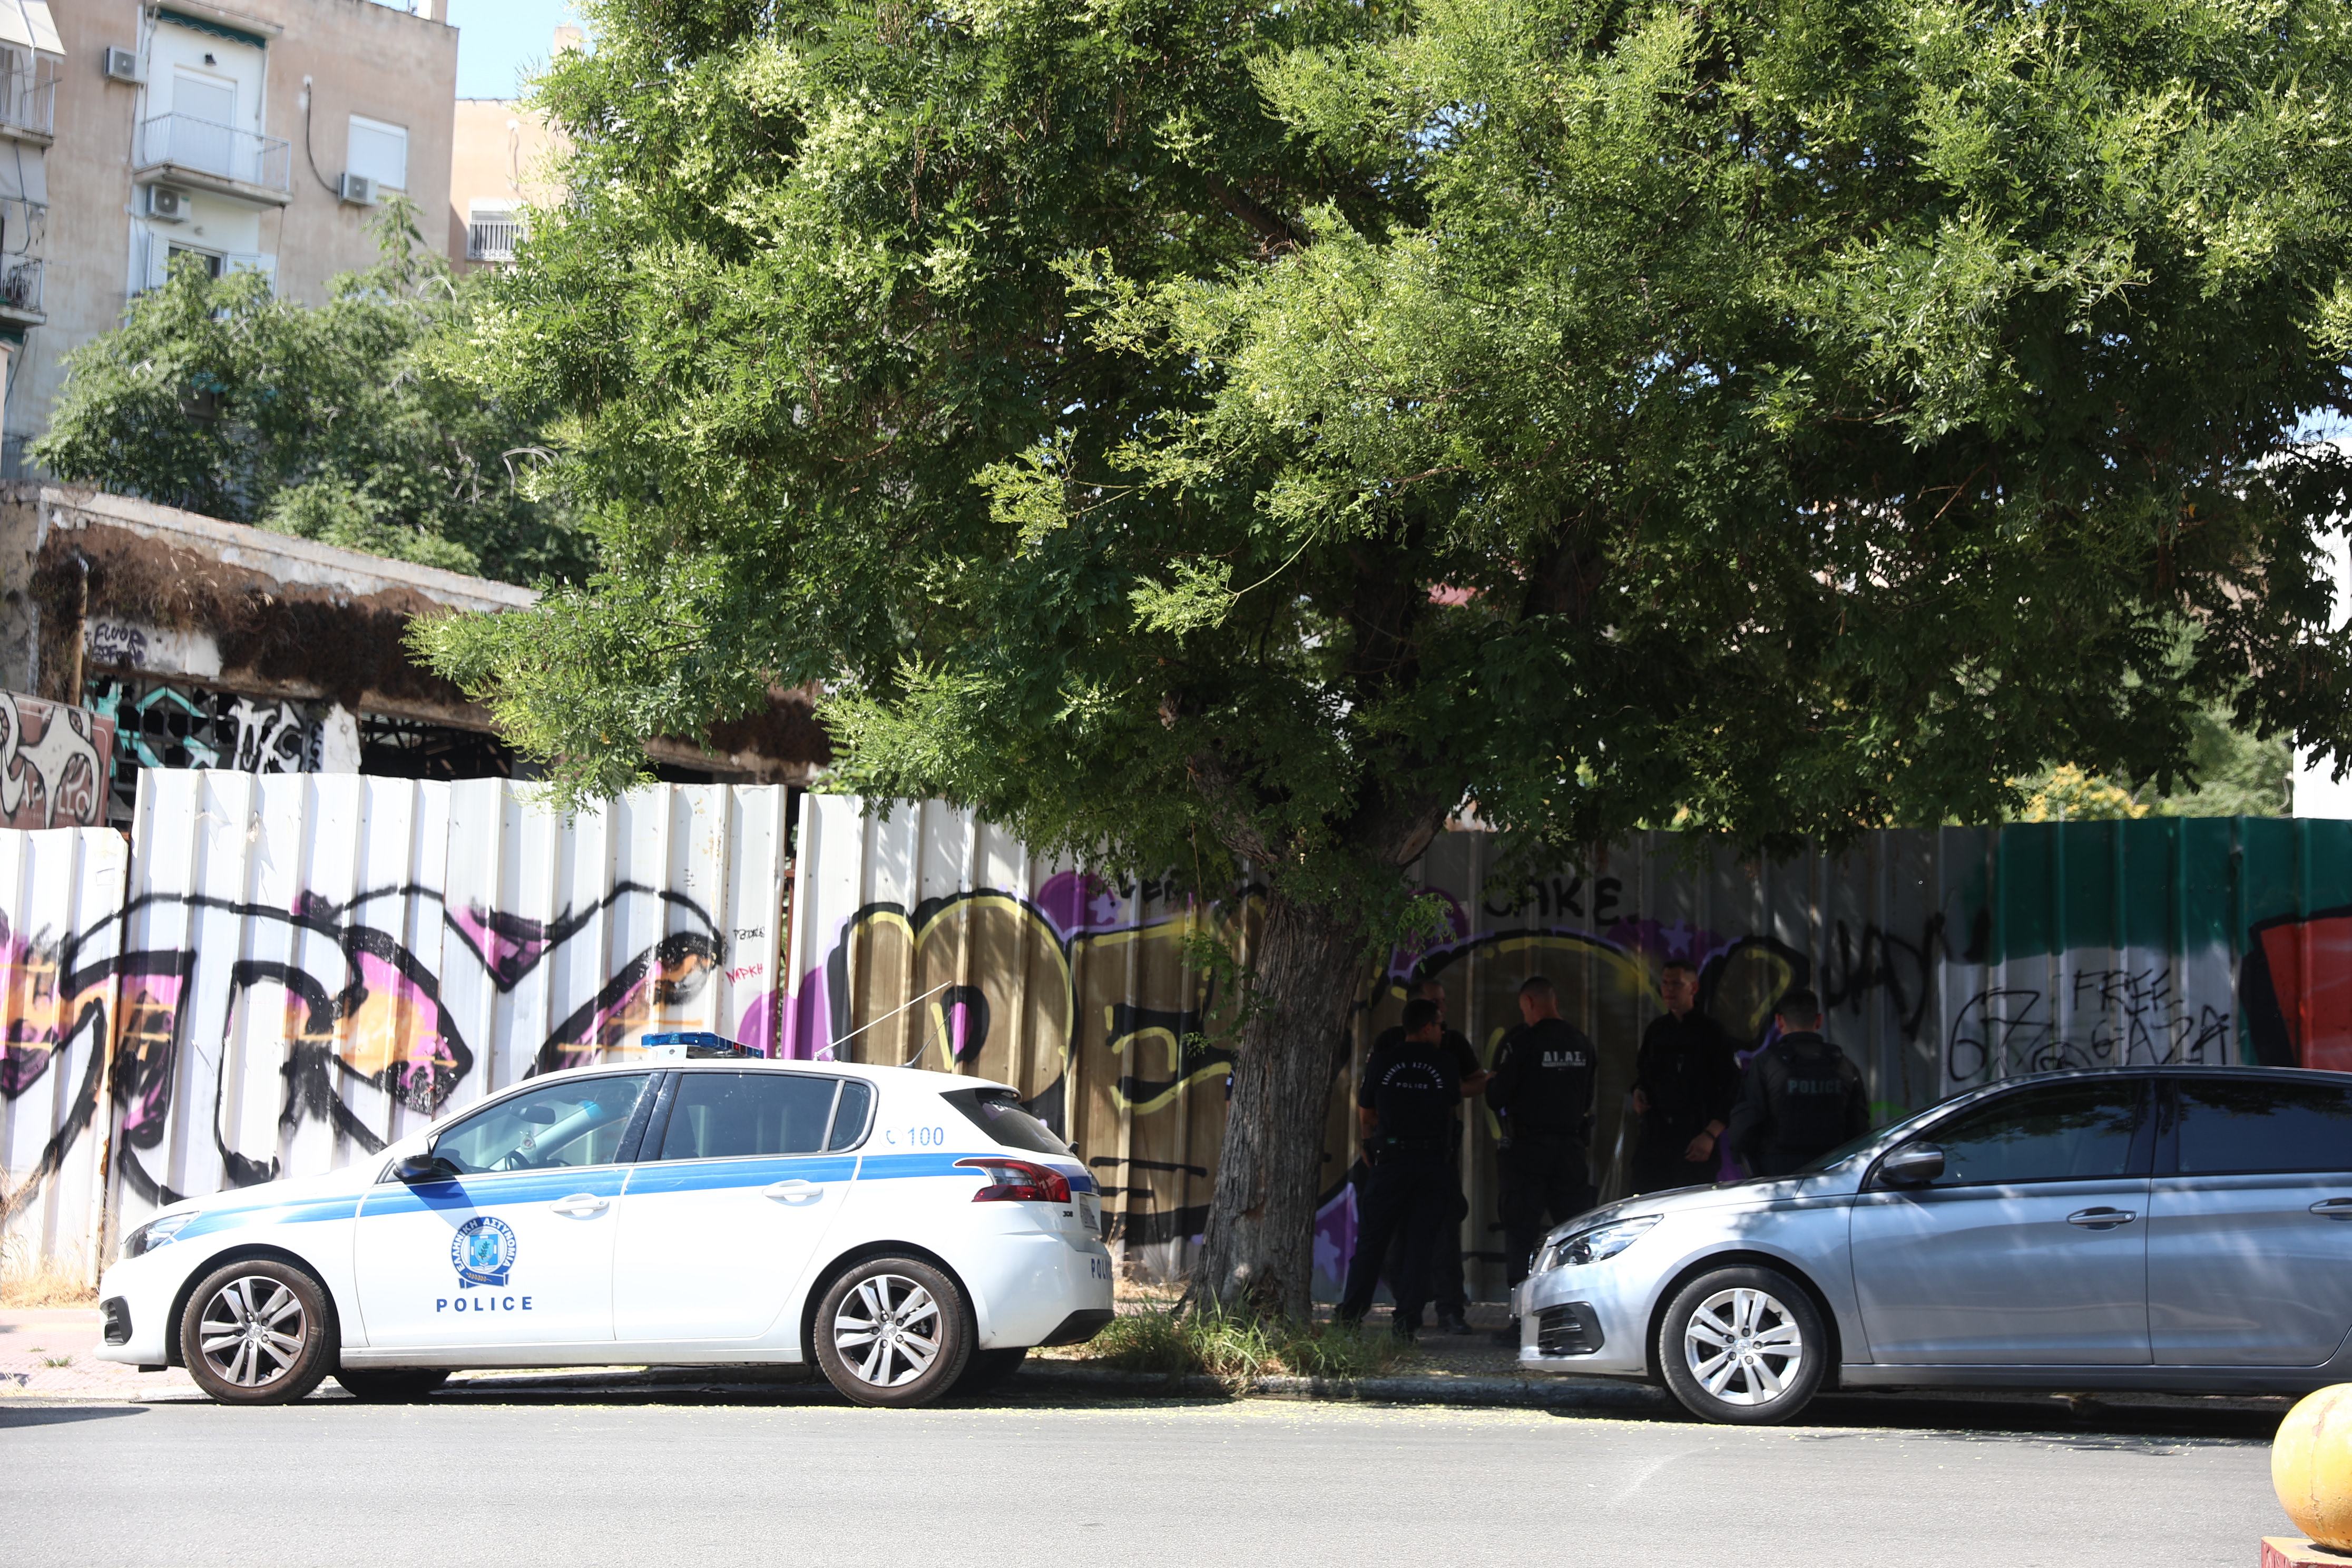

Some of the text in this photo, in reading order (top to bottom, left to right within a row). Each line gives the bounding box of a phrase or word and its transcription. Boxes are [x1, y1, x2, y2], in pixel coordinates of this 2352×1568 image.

[21, 779, 89, 817] APLLO
[1396, 1081, 1428, 1090] POLICE
[1787, 1079, 1843, 1094] POLICE
[907, 1126, 944, 1146] 100
[452, 1217, 516, 1272] ΕΛΛΗΝΙΚΗ ΑΣΤΥΝΟΜΙΑ
[436, 1296, 533, 1312] POLICE
